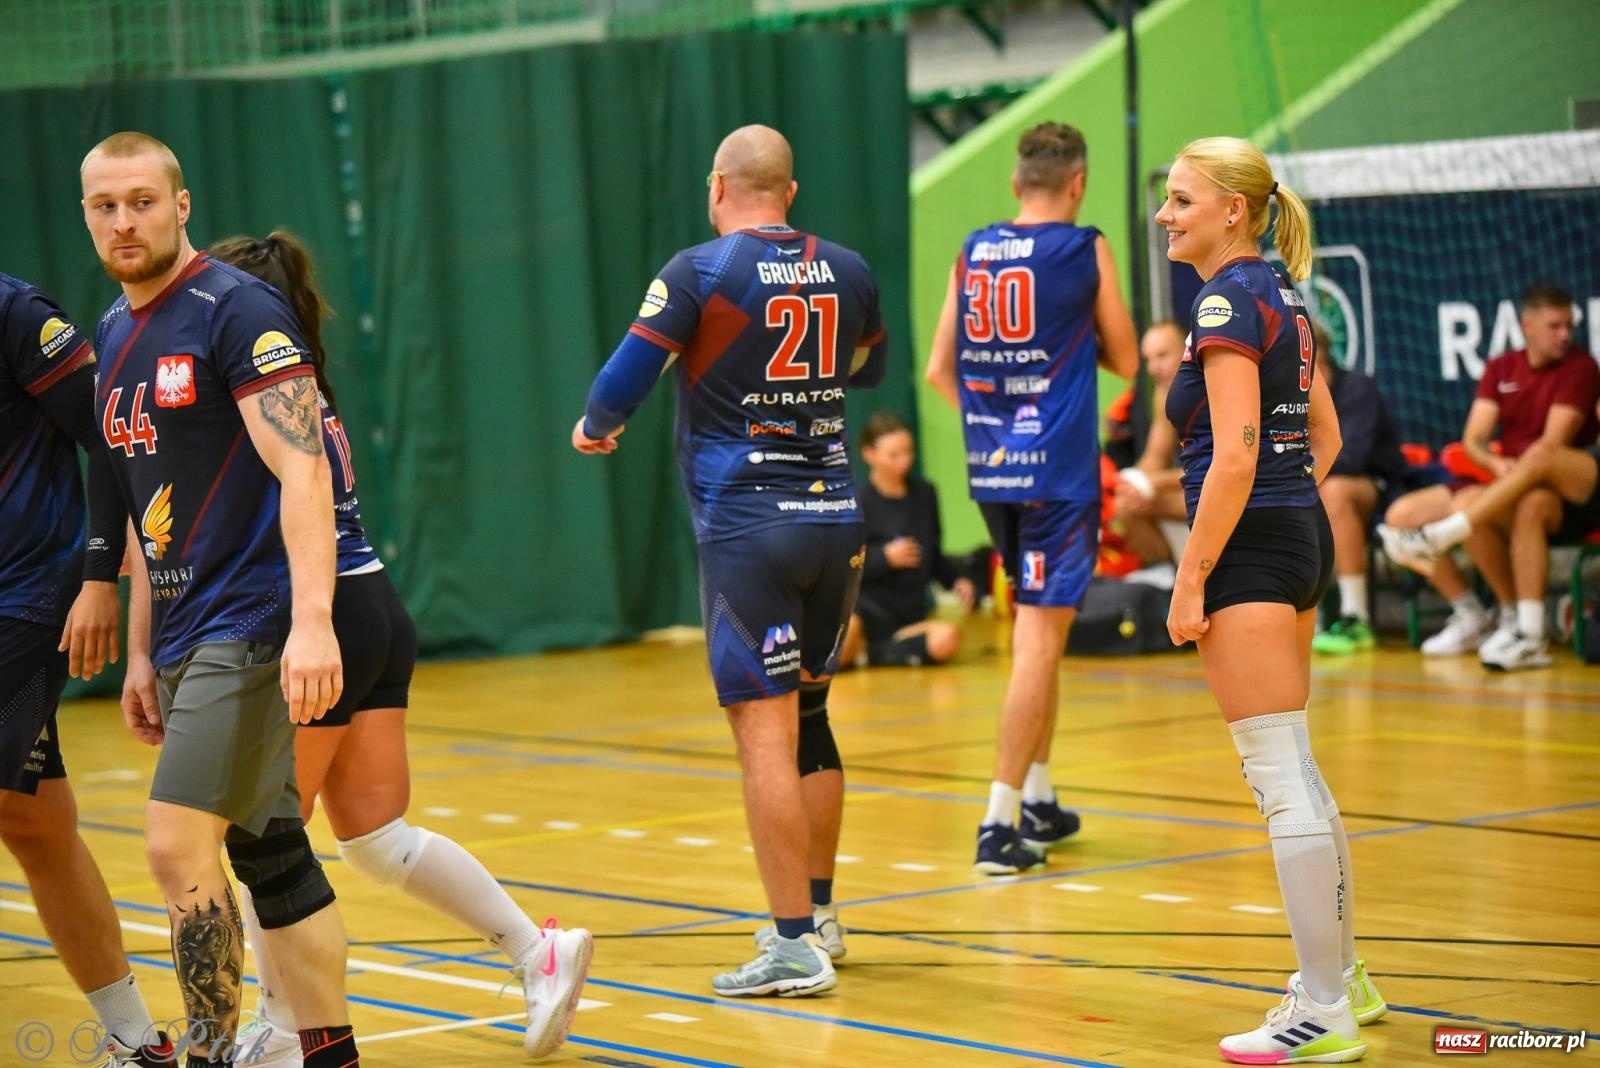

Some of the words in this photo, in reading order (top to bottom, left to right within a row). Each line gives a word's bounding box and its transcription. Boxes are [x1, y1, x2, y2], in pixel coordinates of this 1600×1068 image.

[757, 260, 836, 285] GRUCHA
[964, 266, 1036, 344] 30
[765, 293, 840, 382] 21
[960, 350, 1051, 364] AURATOR
[1296, 314, 1313, 392] 9
[103, 382, 158, 458] 44
[741, 388, 846, 406] AURATOR
